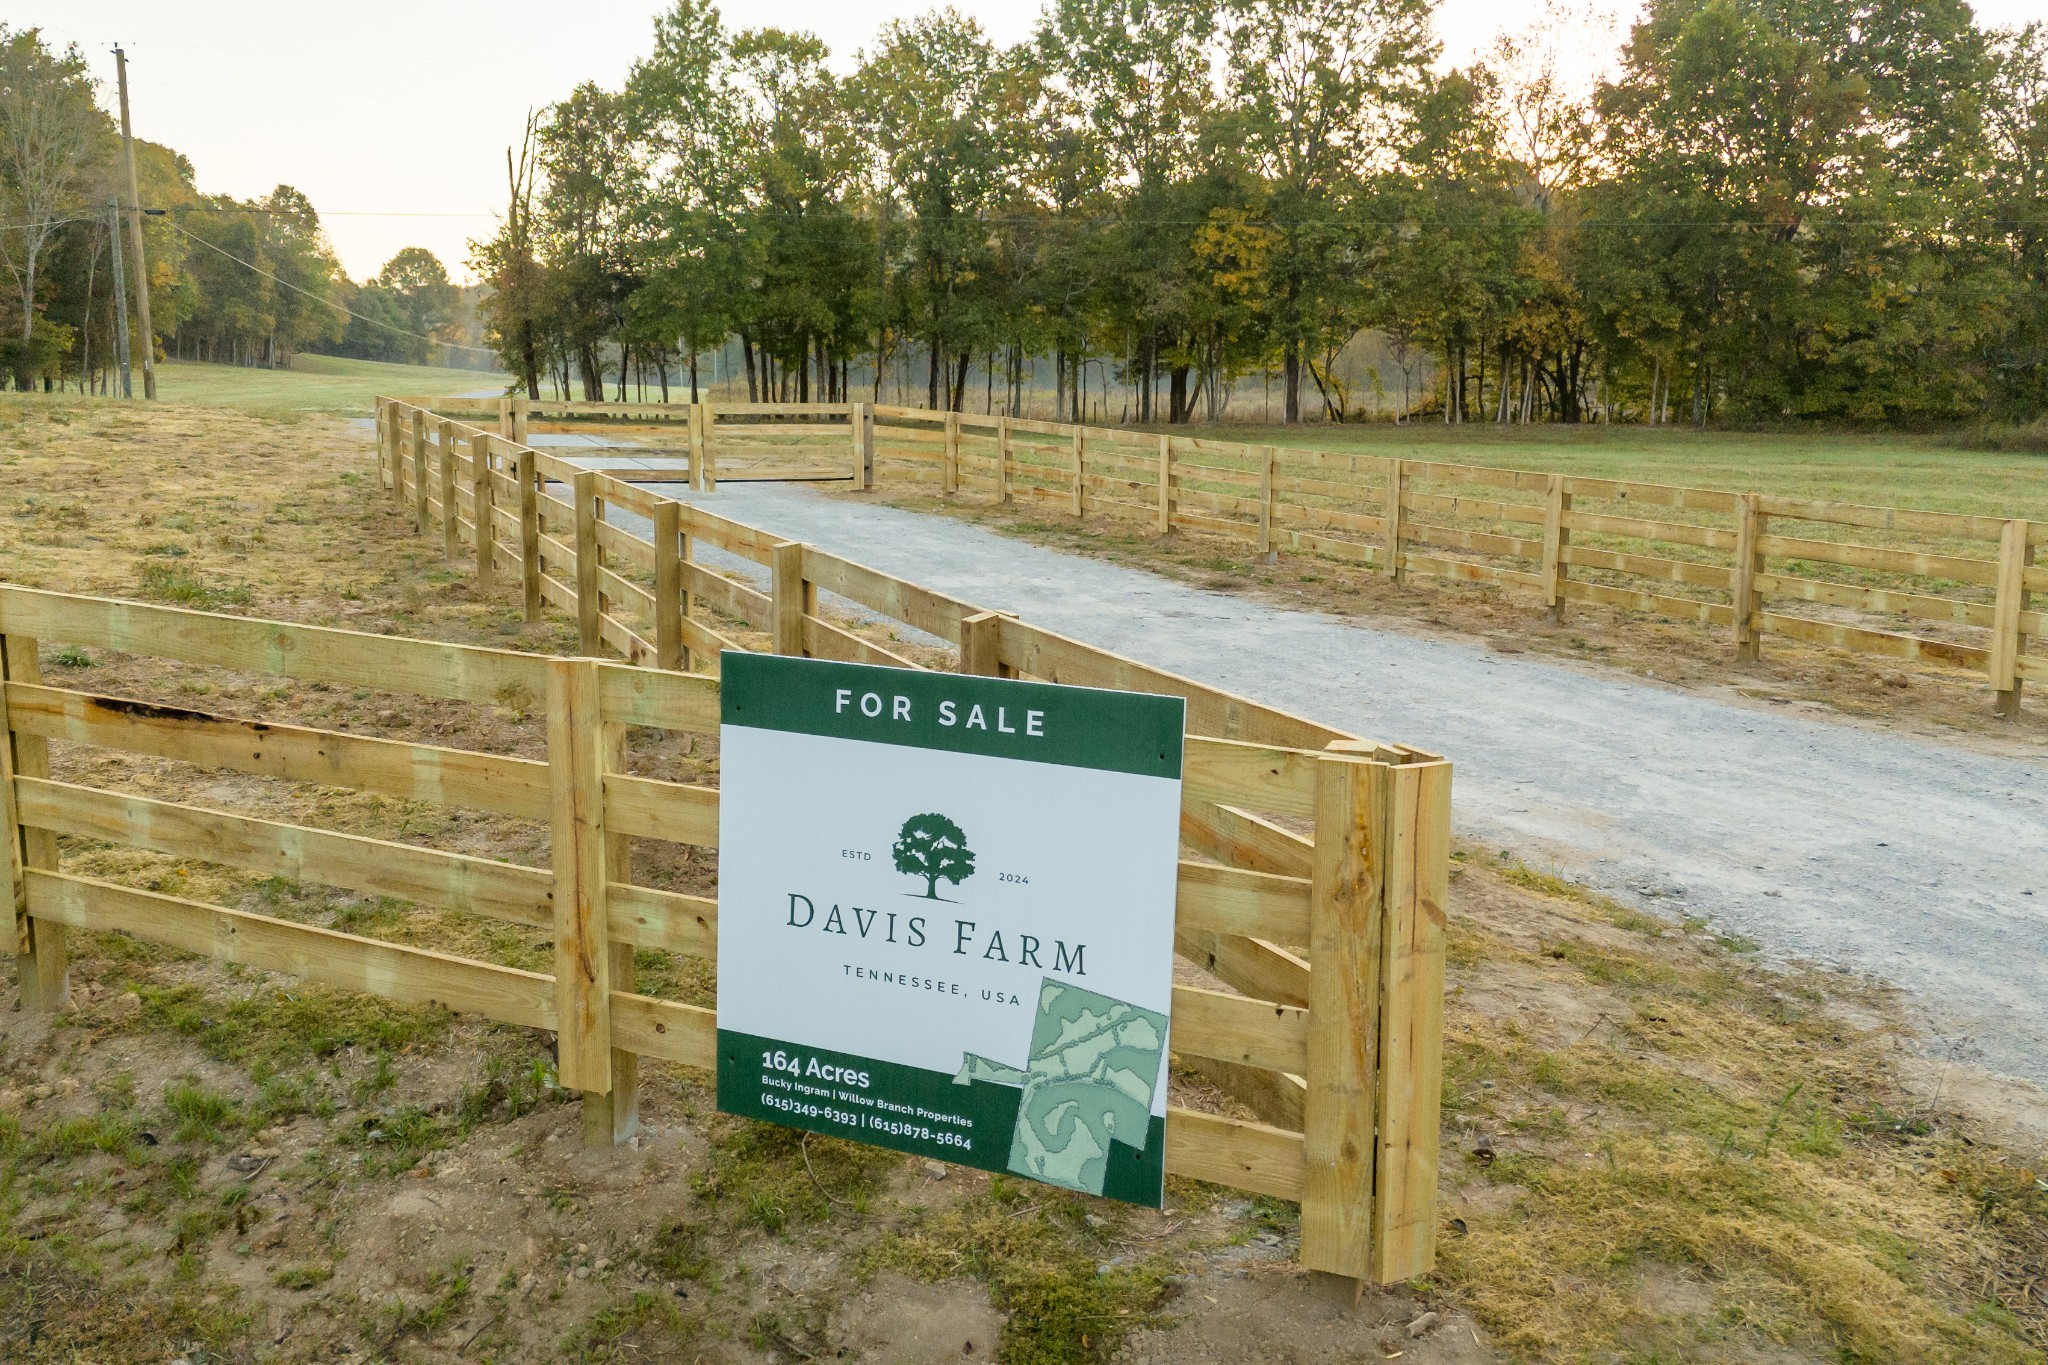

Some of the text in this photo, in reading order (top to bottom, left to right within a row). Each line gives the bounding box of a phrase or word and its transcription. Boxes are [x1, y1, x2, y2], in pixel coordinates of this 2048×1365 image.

[836, 689, 1044, 736] FOR SALE
[842, 849, 1029, 885] ESTD 2024
[787, 891, 1087, 977] DAVIS FARM
[843, 964, 1020, 1006] TENNESSEE, USA
[762, 1050, 870, 1088] 164 Acres
[761, 1075, 792, 1092] Bucky
[794, 1082, 830, 1098] Ingram
[838, 1091, 874, 1107] Willow
[877, 1099, 914, 1115] Branch
[916, 1108, 973, 1128] Properties
[761, 1093, 857, 1126] (615)349-6393
[869, 1115, 972, 1151] (615)878-5664
